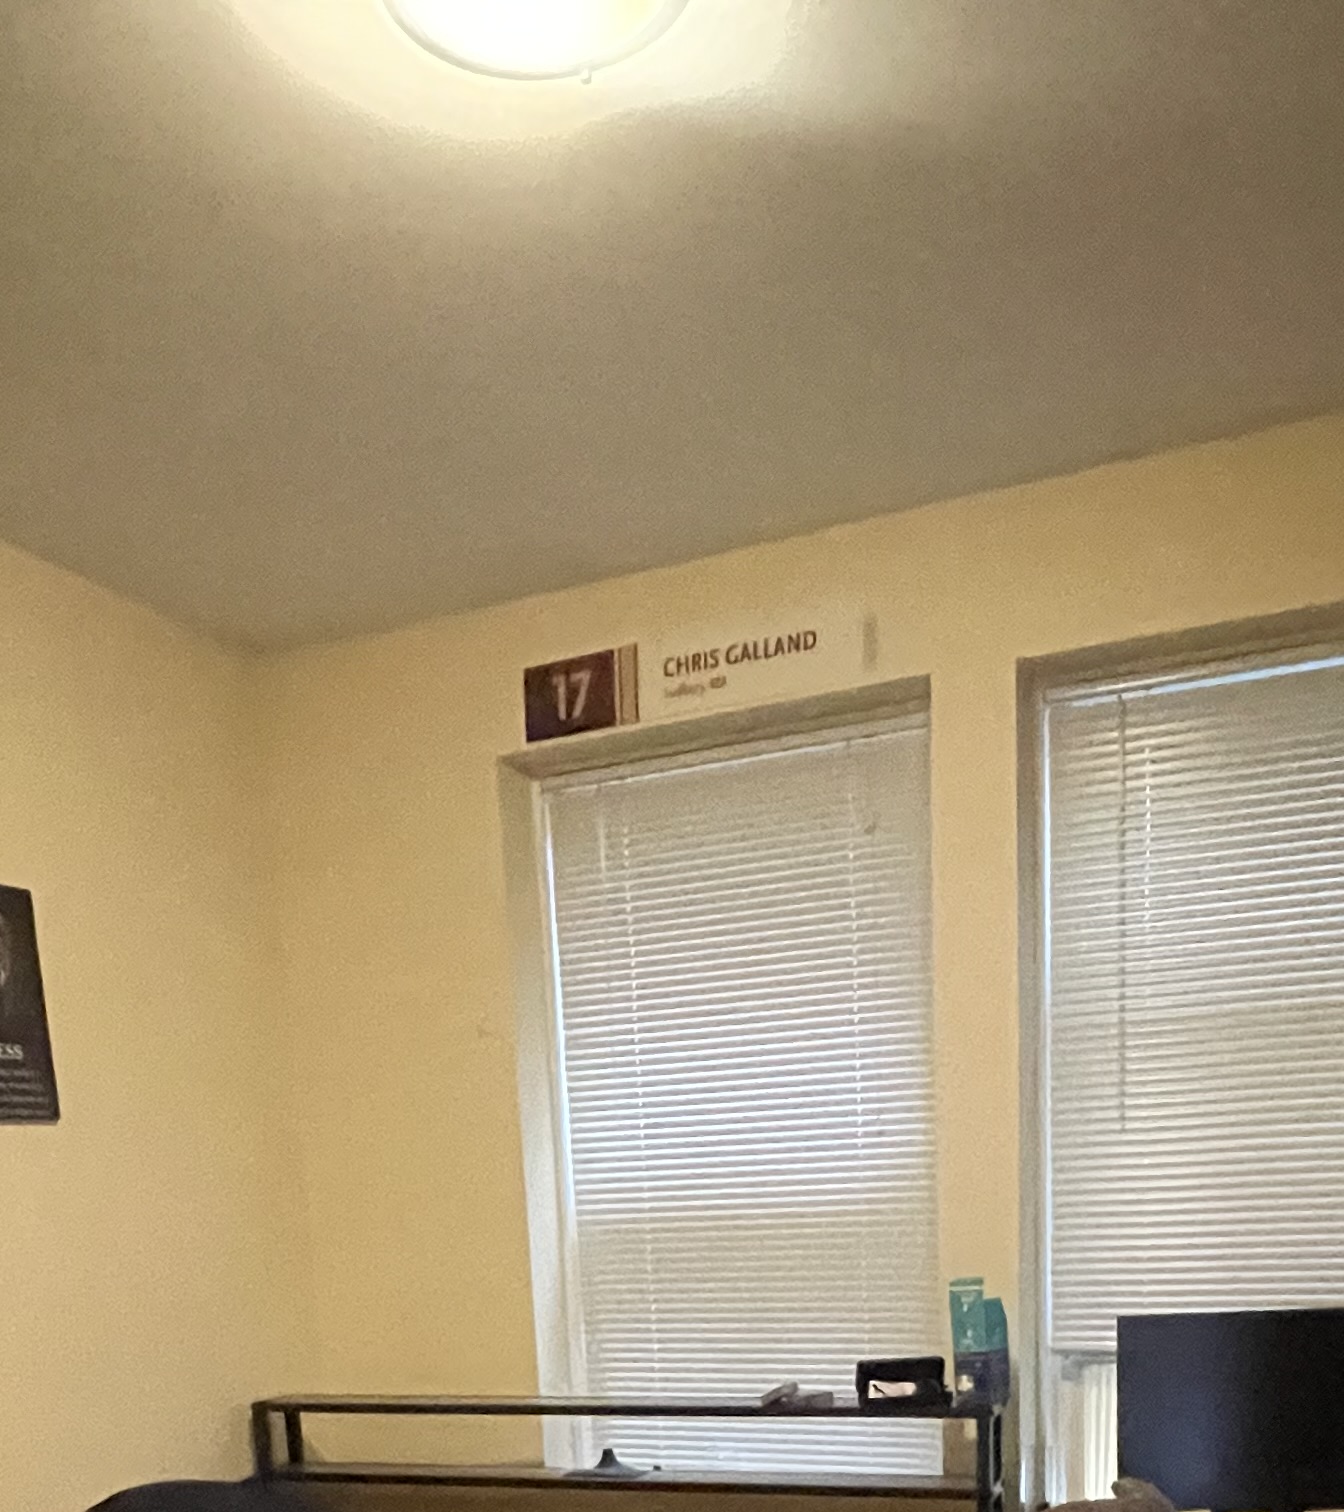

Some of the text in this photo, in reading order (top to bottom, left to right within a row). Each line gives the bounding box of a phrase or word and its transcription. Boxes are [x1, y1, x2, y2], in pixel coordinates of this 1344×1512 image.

[663, 629, 817, 677] CHRIS GALLAND
[552, 669, 592, 720] 17
